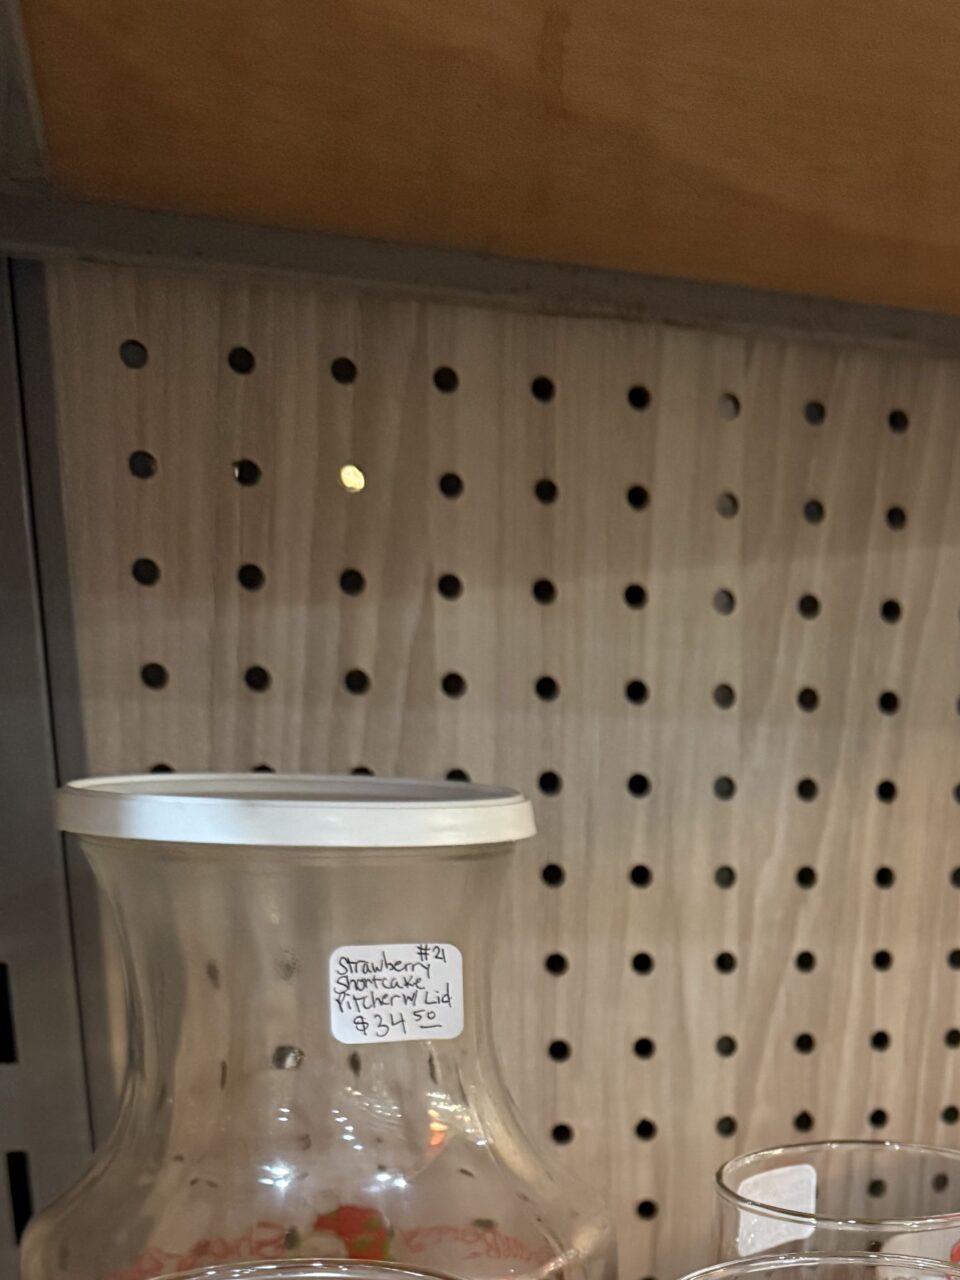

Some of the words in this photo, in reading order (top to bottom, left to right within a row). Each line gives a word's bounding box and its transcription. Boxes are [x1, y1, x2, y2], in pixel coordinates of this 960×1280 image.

[336, 951, 431, 978] Strawberry
[334, 974, 426, 994] Shortcake
[335, 990, 402, 1013] Pitcher
[424, 982, 452, 1008] Lid
